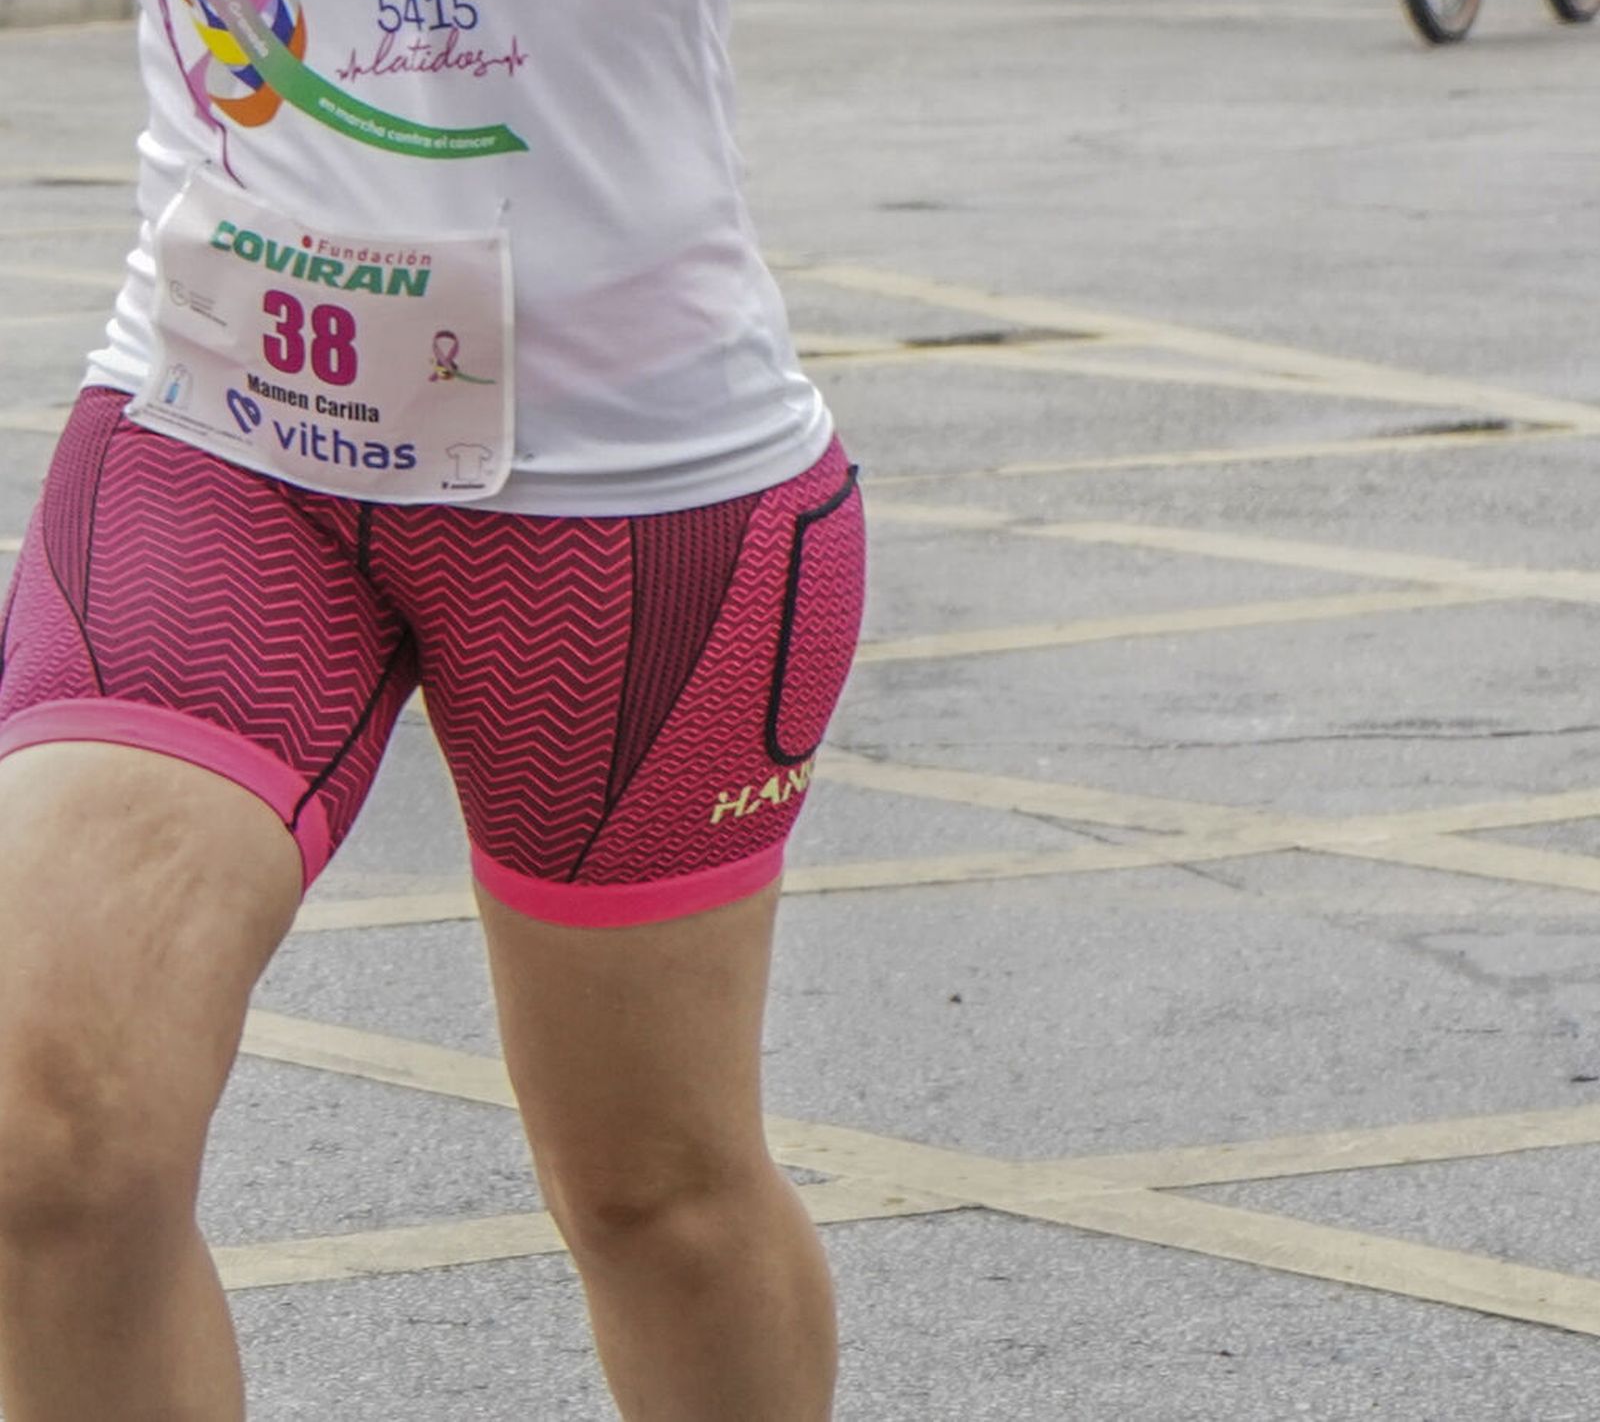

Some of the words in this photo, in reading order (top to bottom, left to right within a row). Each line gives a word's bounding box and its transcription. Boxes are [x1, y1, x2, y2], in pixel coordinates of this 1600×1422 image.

[318, 239, 432, 265] Fundación
[263, 289, 358, 386] 38
[247, 373, 309, 409] Mamen
[315, 394, 380, 423] Carilla
[273, 420, 417, 469] vithas
